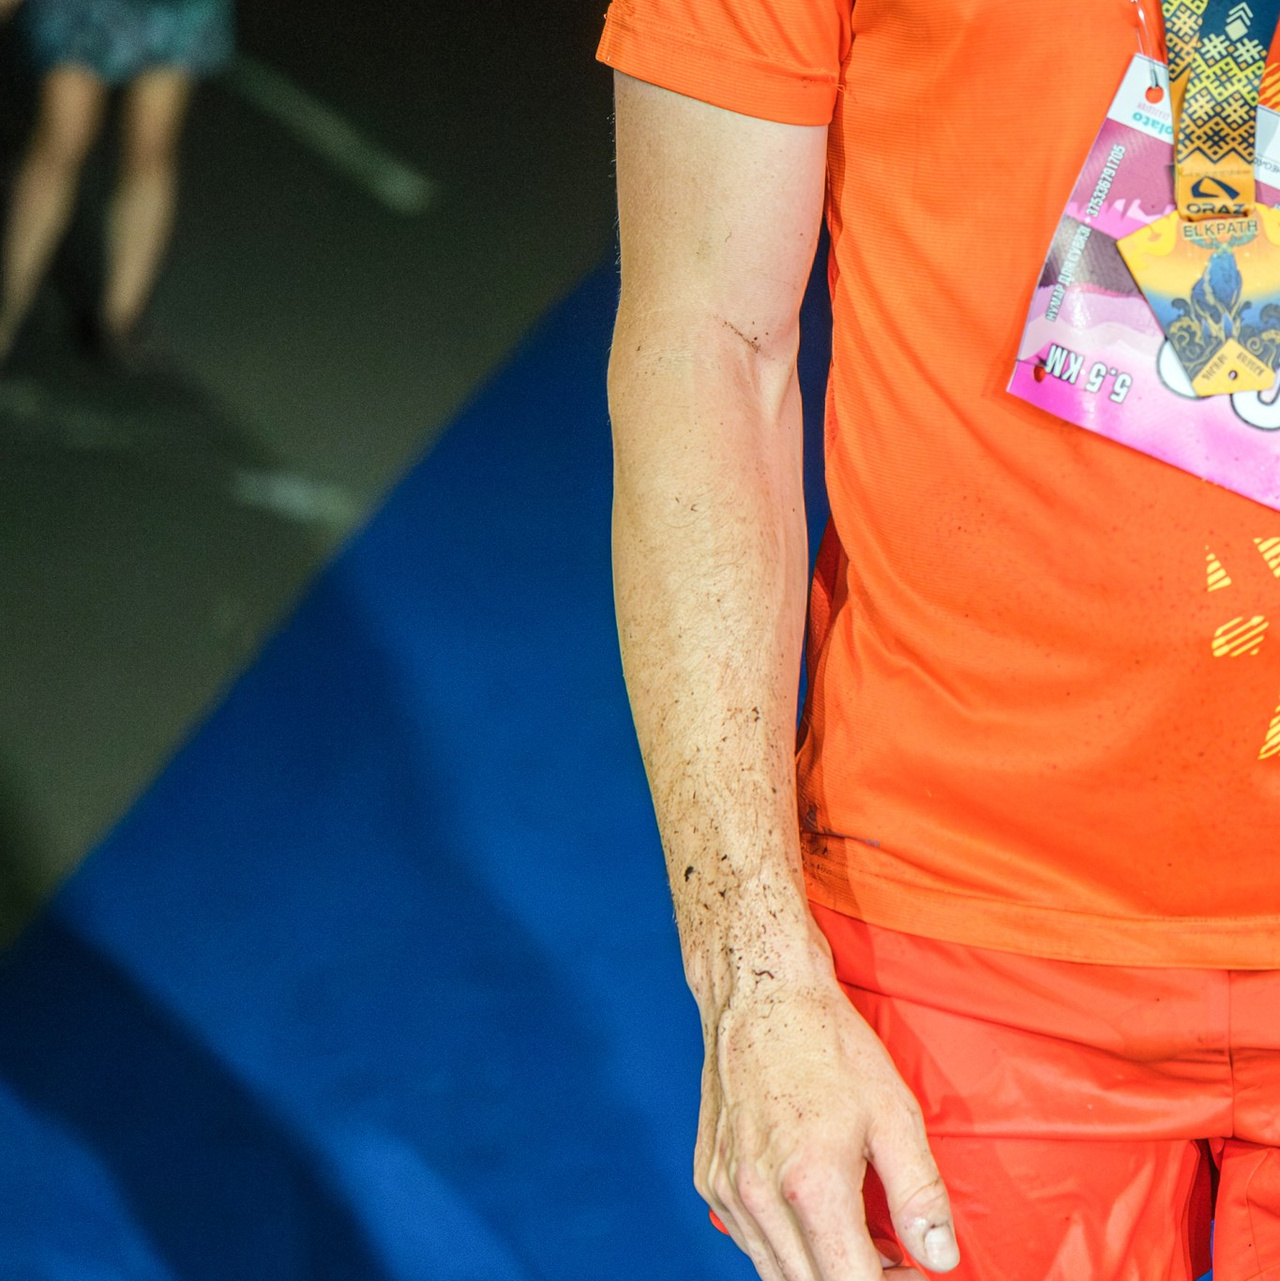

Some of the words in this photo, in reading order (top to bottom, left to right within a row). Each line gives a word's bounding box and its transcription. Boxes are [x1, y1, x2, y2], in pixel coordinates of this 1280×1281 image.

[1087, 144, 1125, 217] 375336791705
[1183, 219, 1258, 239] ELKPATH
[1186, 203, 1247, 215] ORAZ
[1044, 344, 1084, 385] KM
[1084, 361, 1133, 403] 5.5
